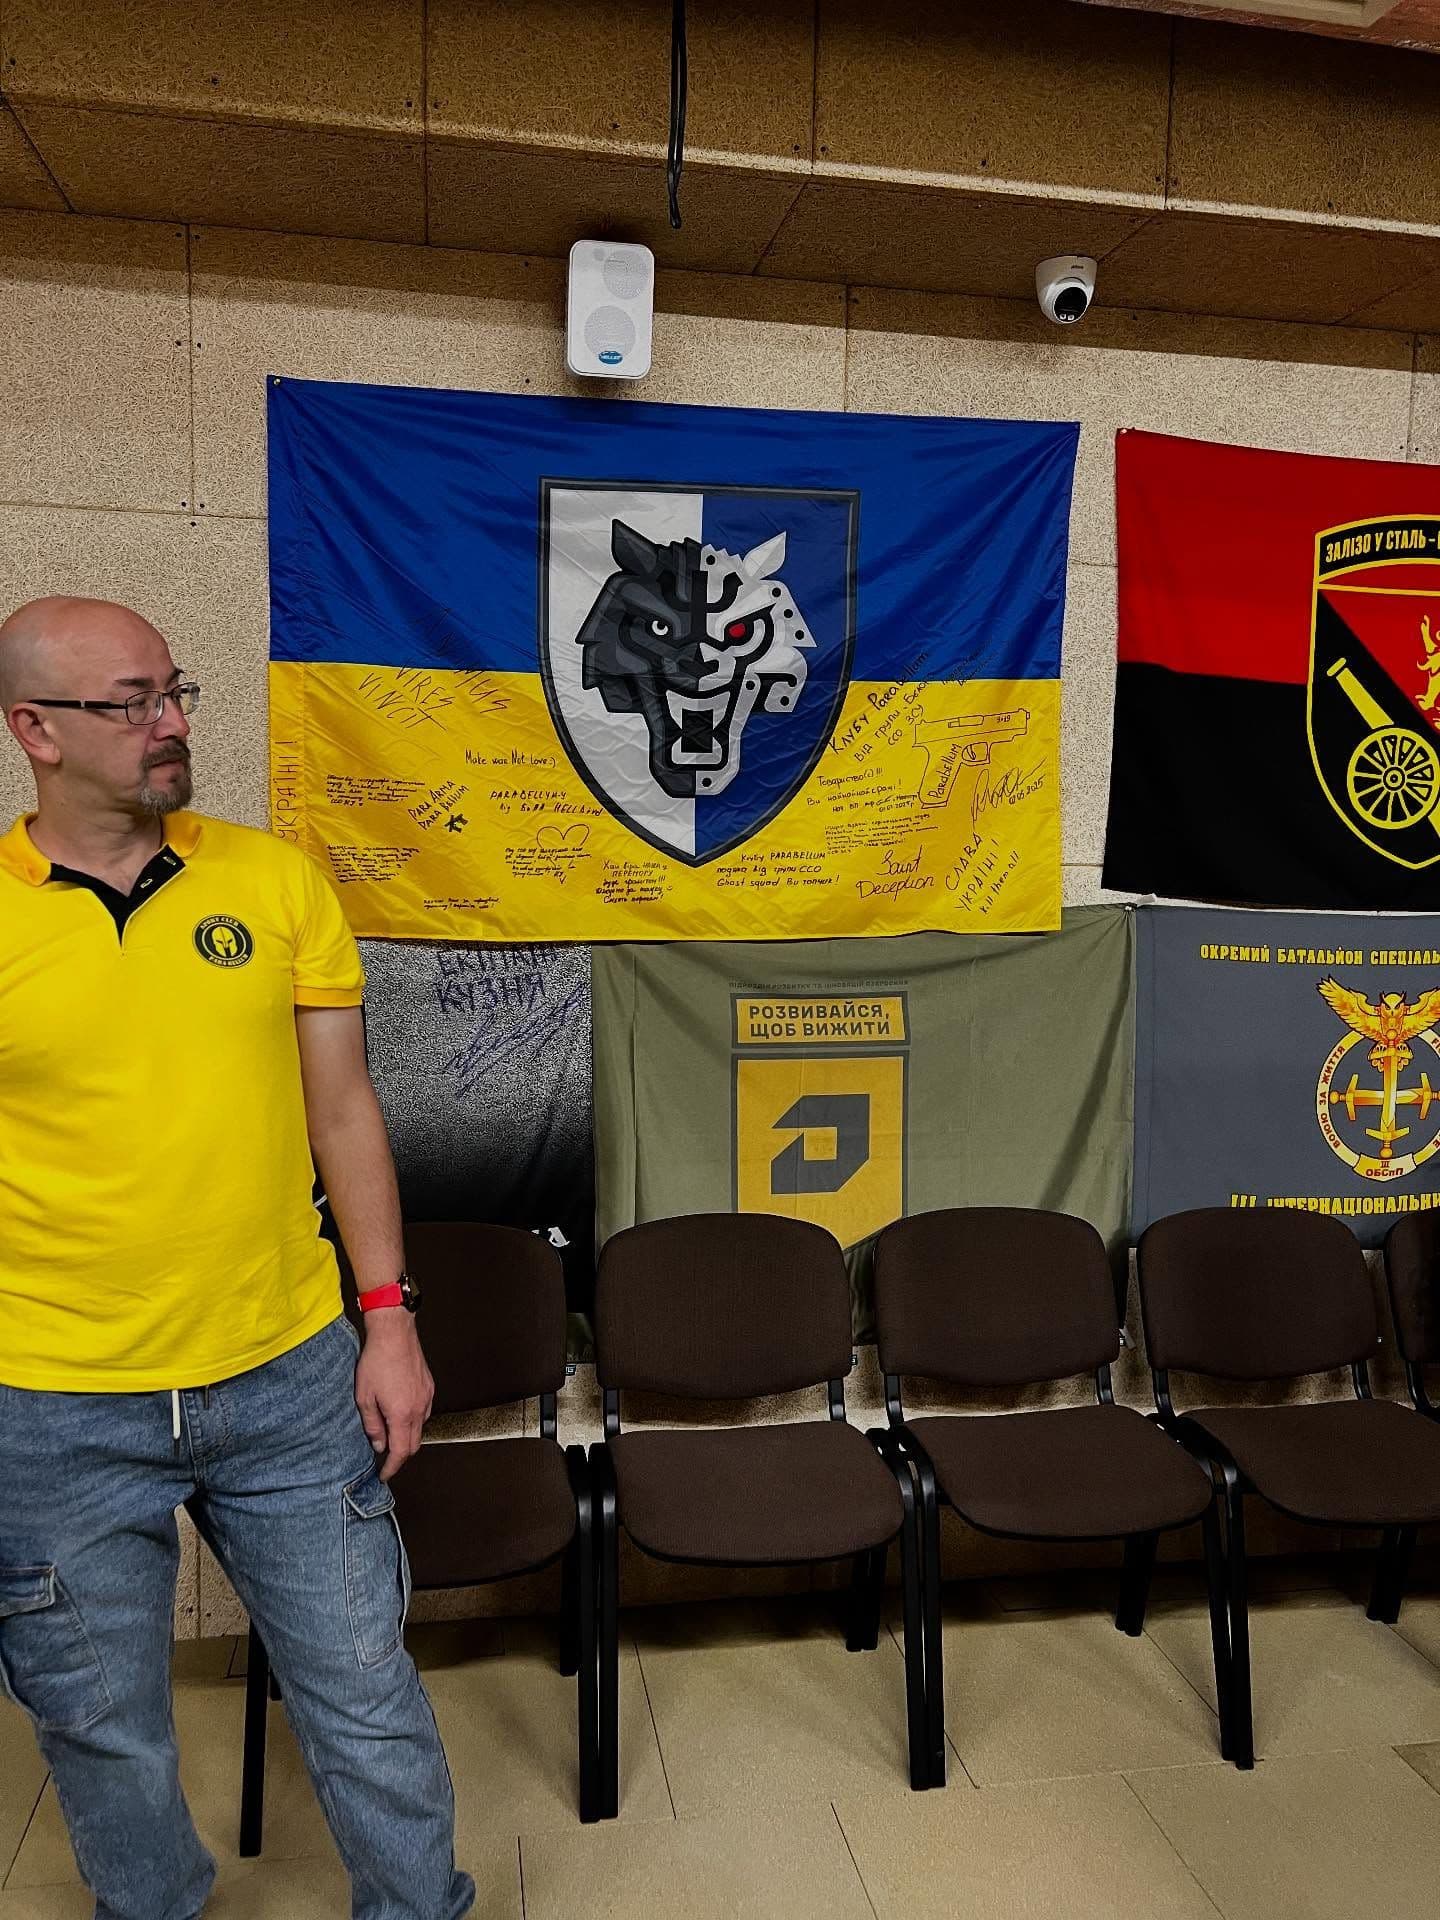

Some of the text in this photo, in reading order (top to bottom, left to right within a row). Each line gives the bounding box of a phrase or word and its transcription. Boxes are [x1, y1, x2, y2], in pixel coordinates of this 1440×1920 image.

[1326, 533, 1371, 562] ЗАЛІЗО
[1375, 532, 1383, 551] У
[1386, 530, 1426, 550] СТАЛЬ
[465, 749, 487, 765] Make
[946, 832, 983, 890] СЛАВА
[1200, 944, 1270, 963] ОКРЕМИЙ
[1277, 946, 1363, 965] БАТАЛЬЙОН
[750, 1001, 890, 1020] РОЗВИВАЙСЯ,
[751, 1021, 890, 1039] ЩОБ ВИЖИТИ
[1319, 1046, 1346, 1149] ВОЮ ЗА ЖИТТЯ
